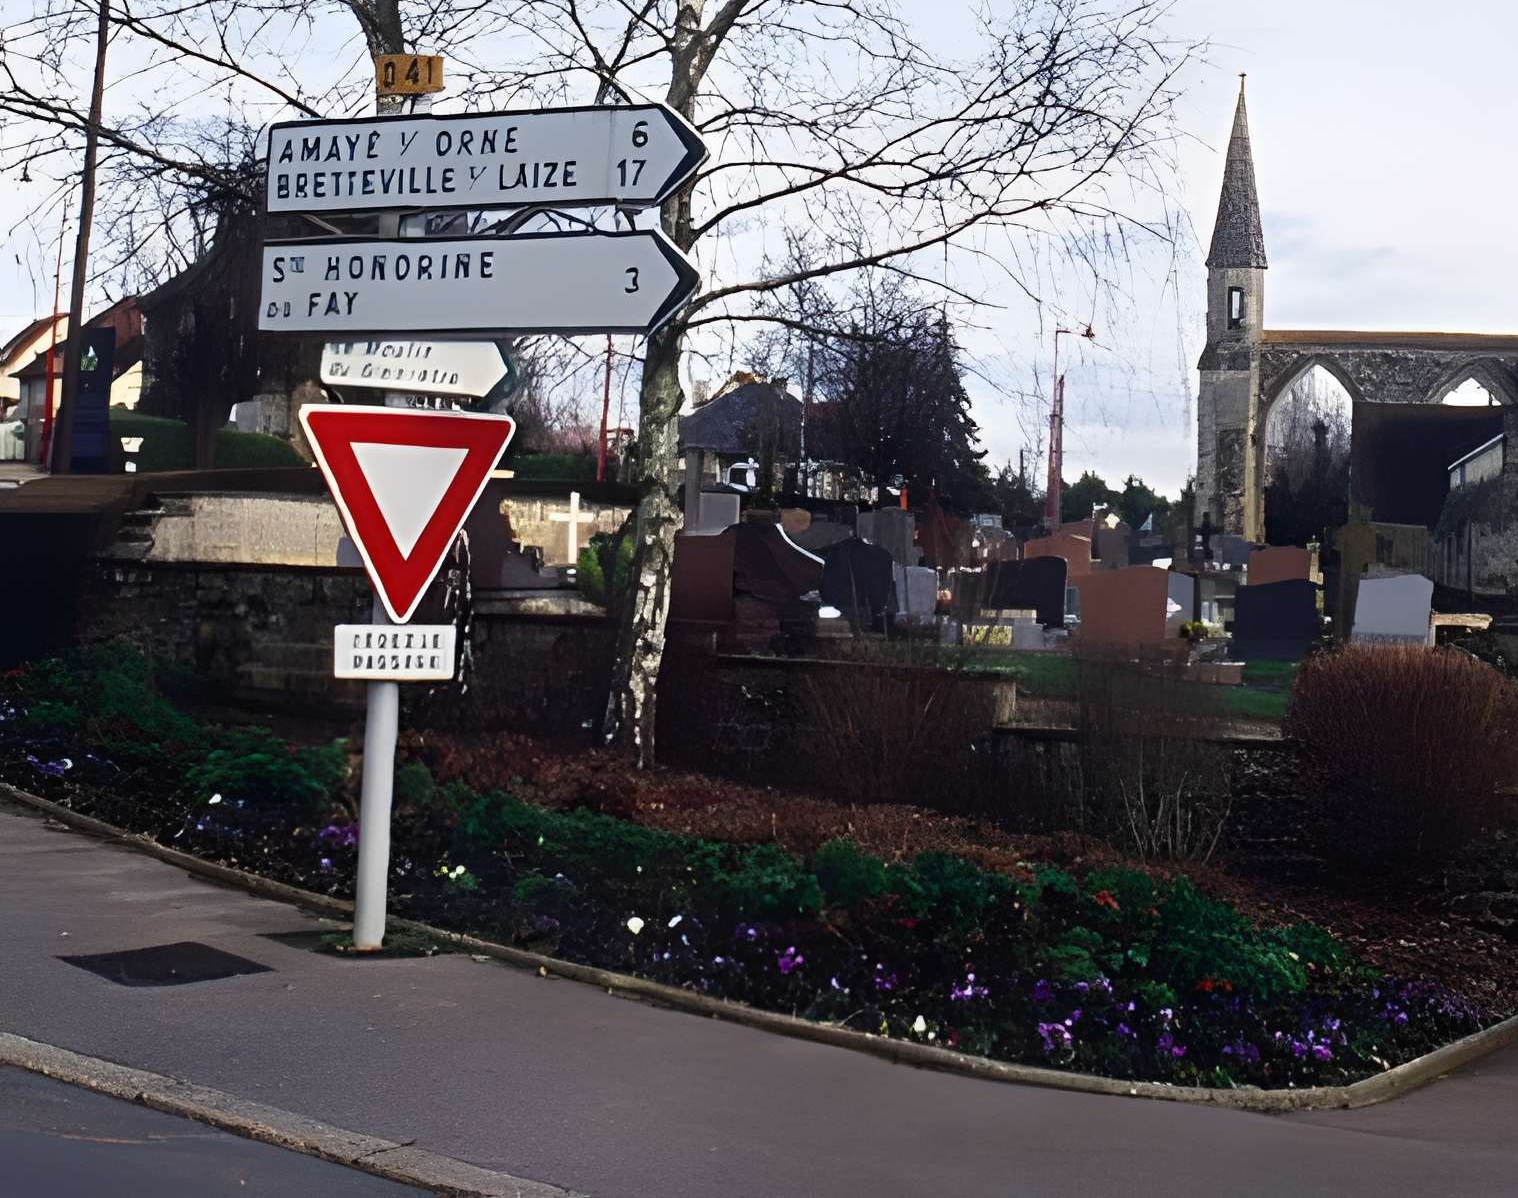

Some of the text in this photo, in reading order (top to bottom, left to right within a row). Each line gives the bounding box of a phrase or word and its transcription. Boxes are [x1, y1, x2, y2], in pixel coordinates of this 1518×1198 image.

[436, 128, 518, 156] ORNE
[632, 121, 648, 148] 6
[277, 166, 455, 198] BRETTEVILLE
[499, 161, 577, 190] LAIZE
[617, 159, 646, 186] 17
[324, 252, 494, 280] HONORINE
[625, 267, 639, 293] 3
[308, 292, 359, 316] FAY
